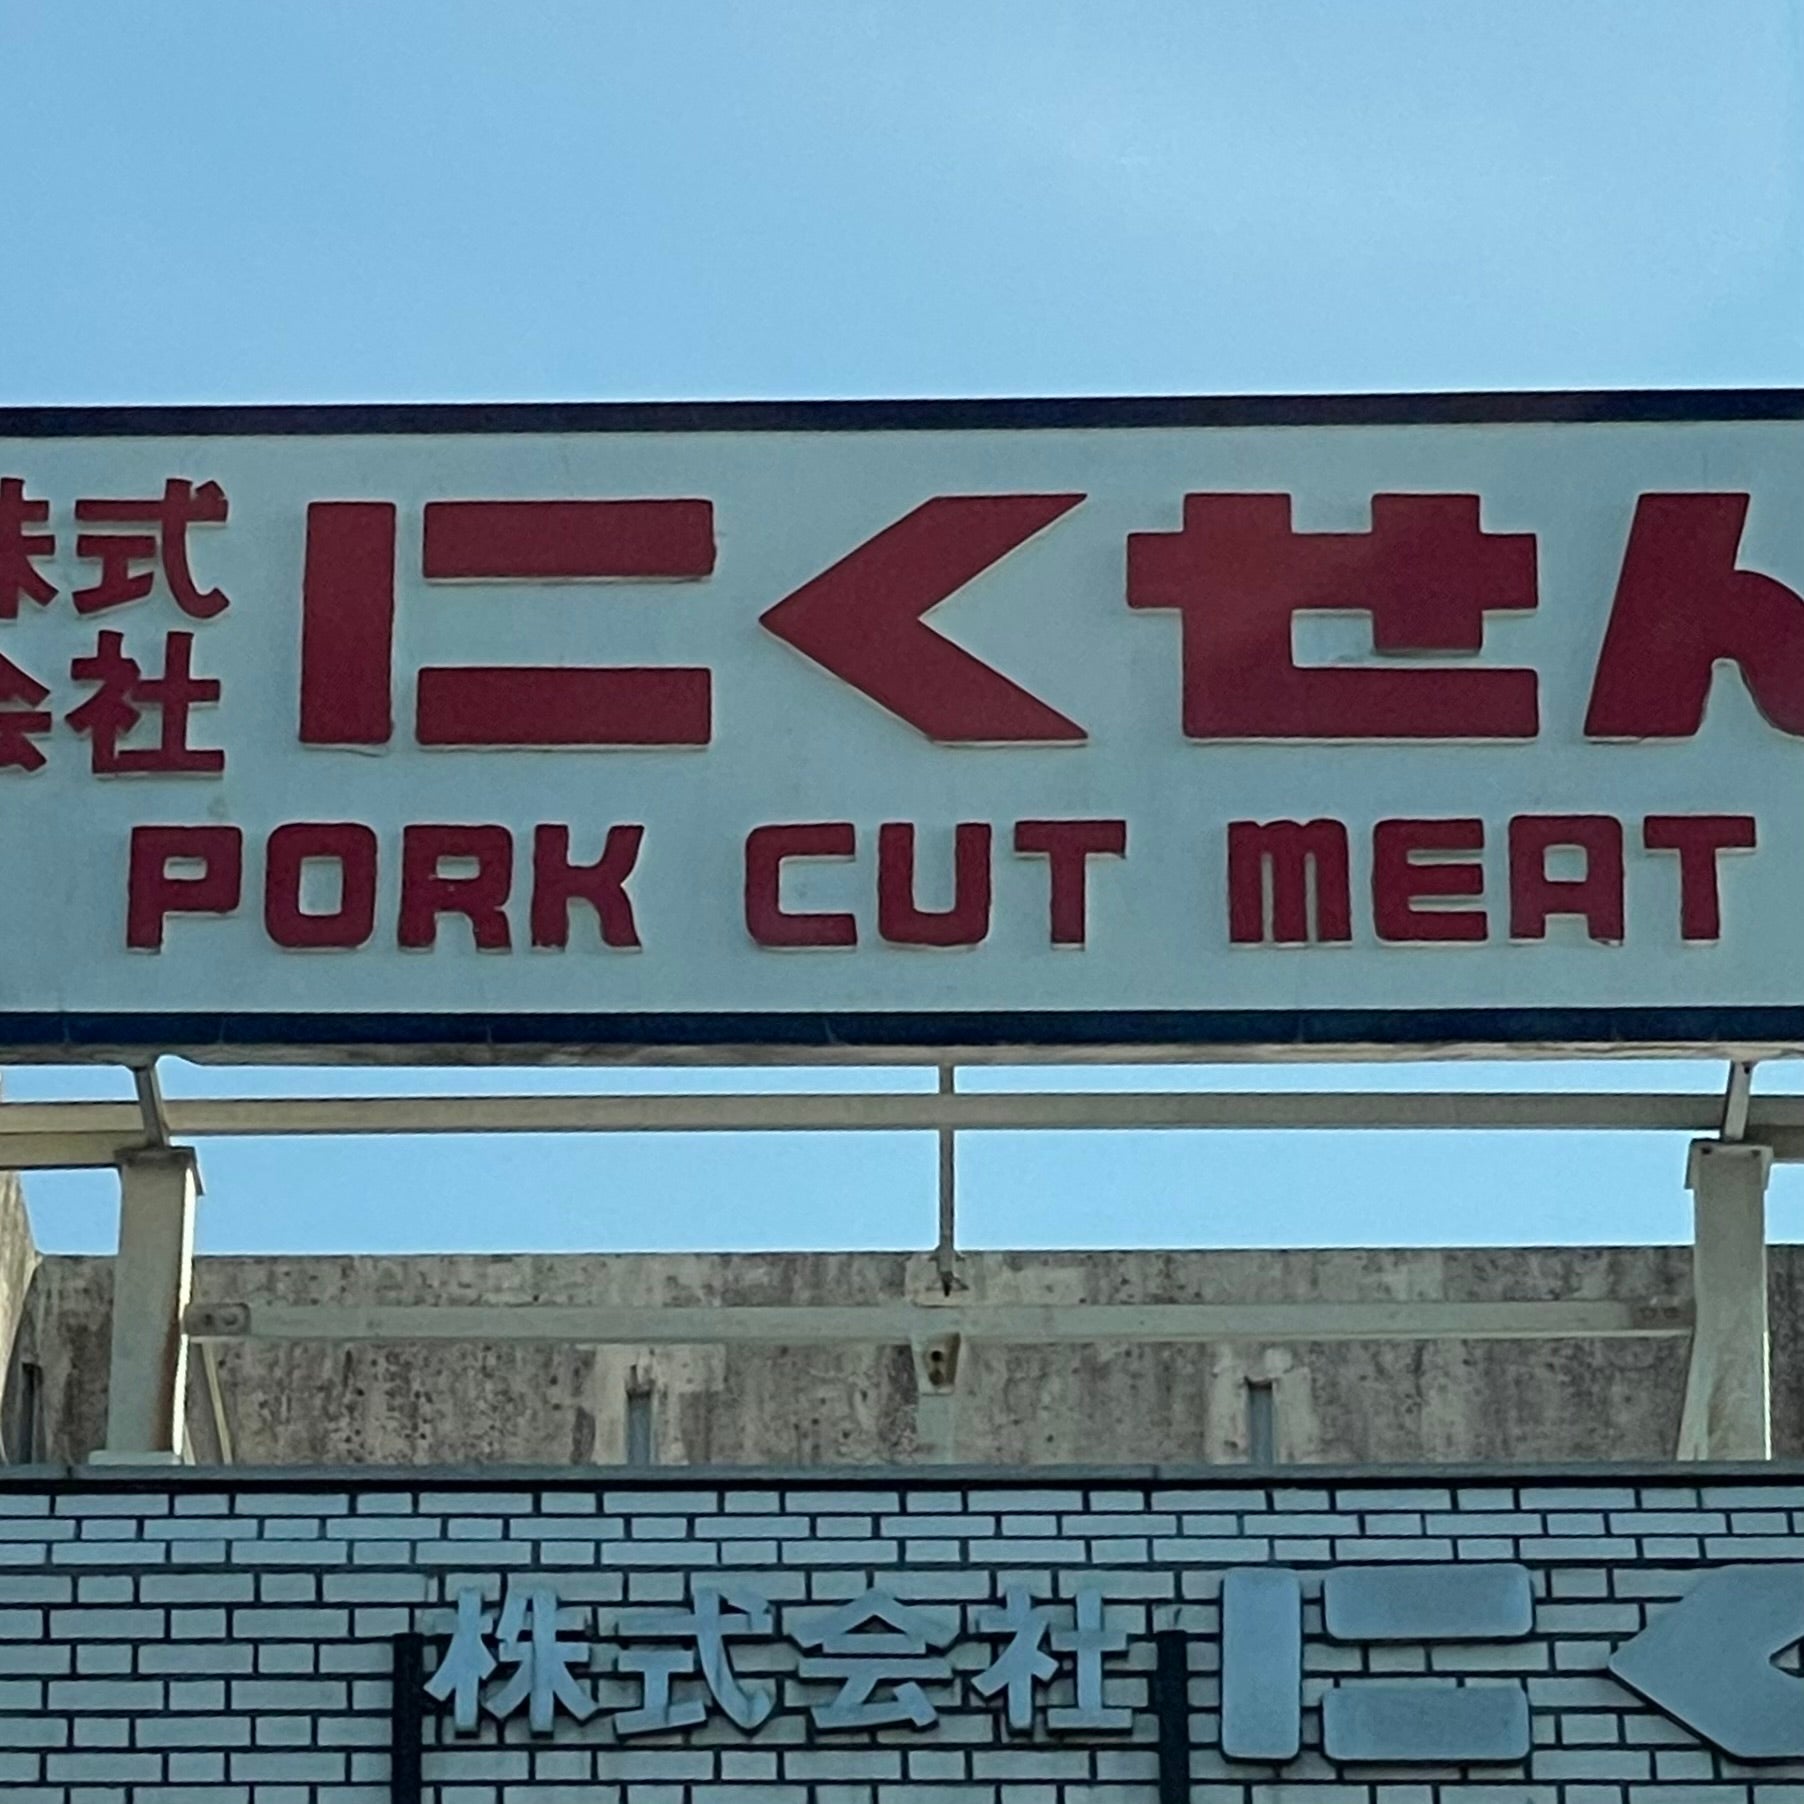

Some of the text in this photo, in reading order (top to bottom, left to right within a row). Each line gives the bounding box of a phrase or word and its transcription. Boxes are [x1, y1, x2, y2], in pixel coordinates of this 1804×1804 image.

[127, 814, 1757, 952] PORK CUT MEAT
[423, 1585, 1134, 1738] 株式会社
